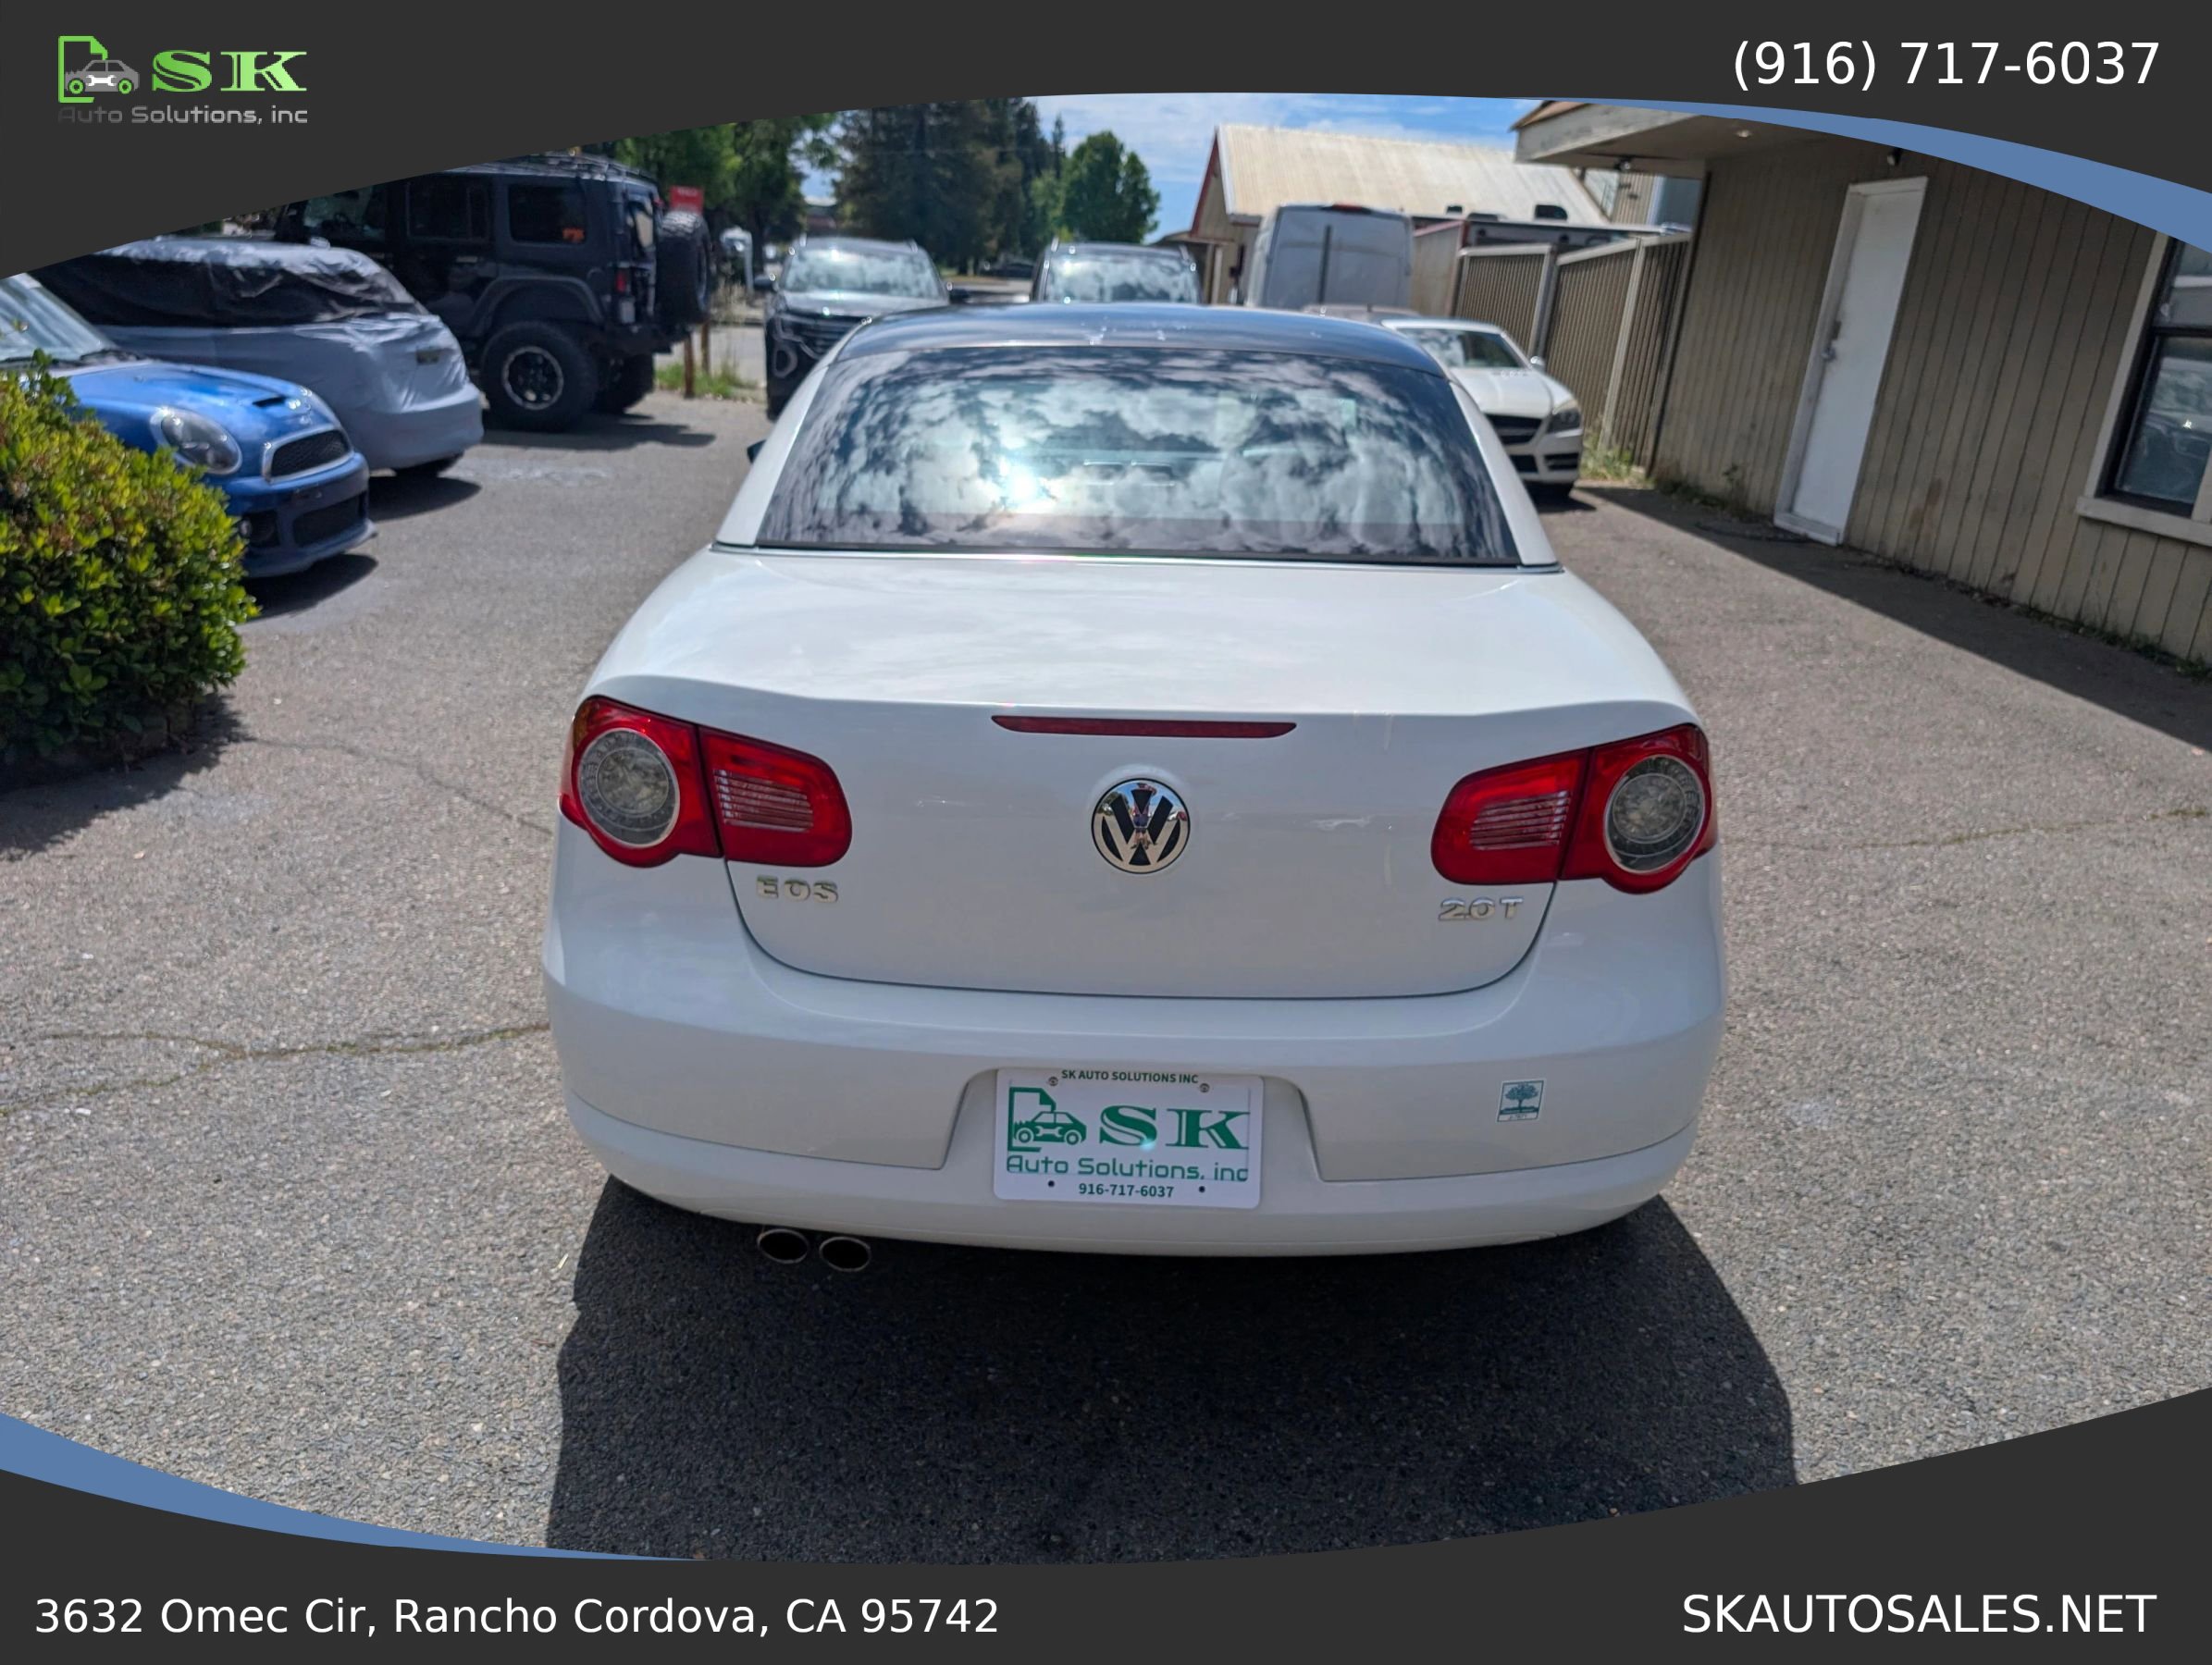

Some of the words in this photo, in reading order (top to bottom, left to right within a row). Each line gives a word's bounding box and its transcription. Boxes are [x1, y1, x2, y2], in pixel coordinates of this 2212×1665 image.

[756, 874, 839, 904] EOS
[1061, 1069, 1076, 1080] SK
[1078, 1070, 1109, 1081] AUTO
[1111, 1071, 1177, 1083] SOLUTIONS
[1179, 1073, 1199, 1084] INC
[1099, 1104, 1251, 1151] SK
[1007, 1153, 1069, 1175] Auto
[1214, 1162, 1249, 1182] inc
[1078, 1182, 1175, 1199] 916-717-6037
